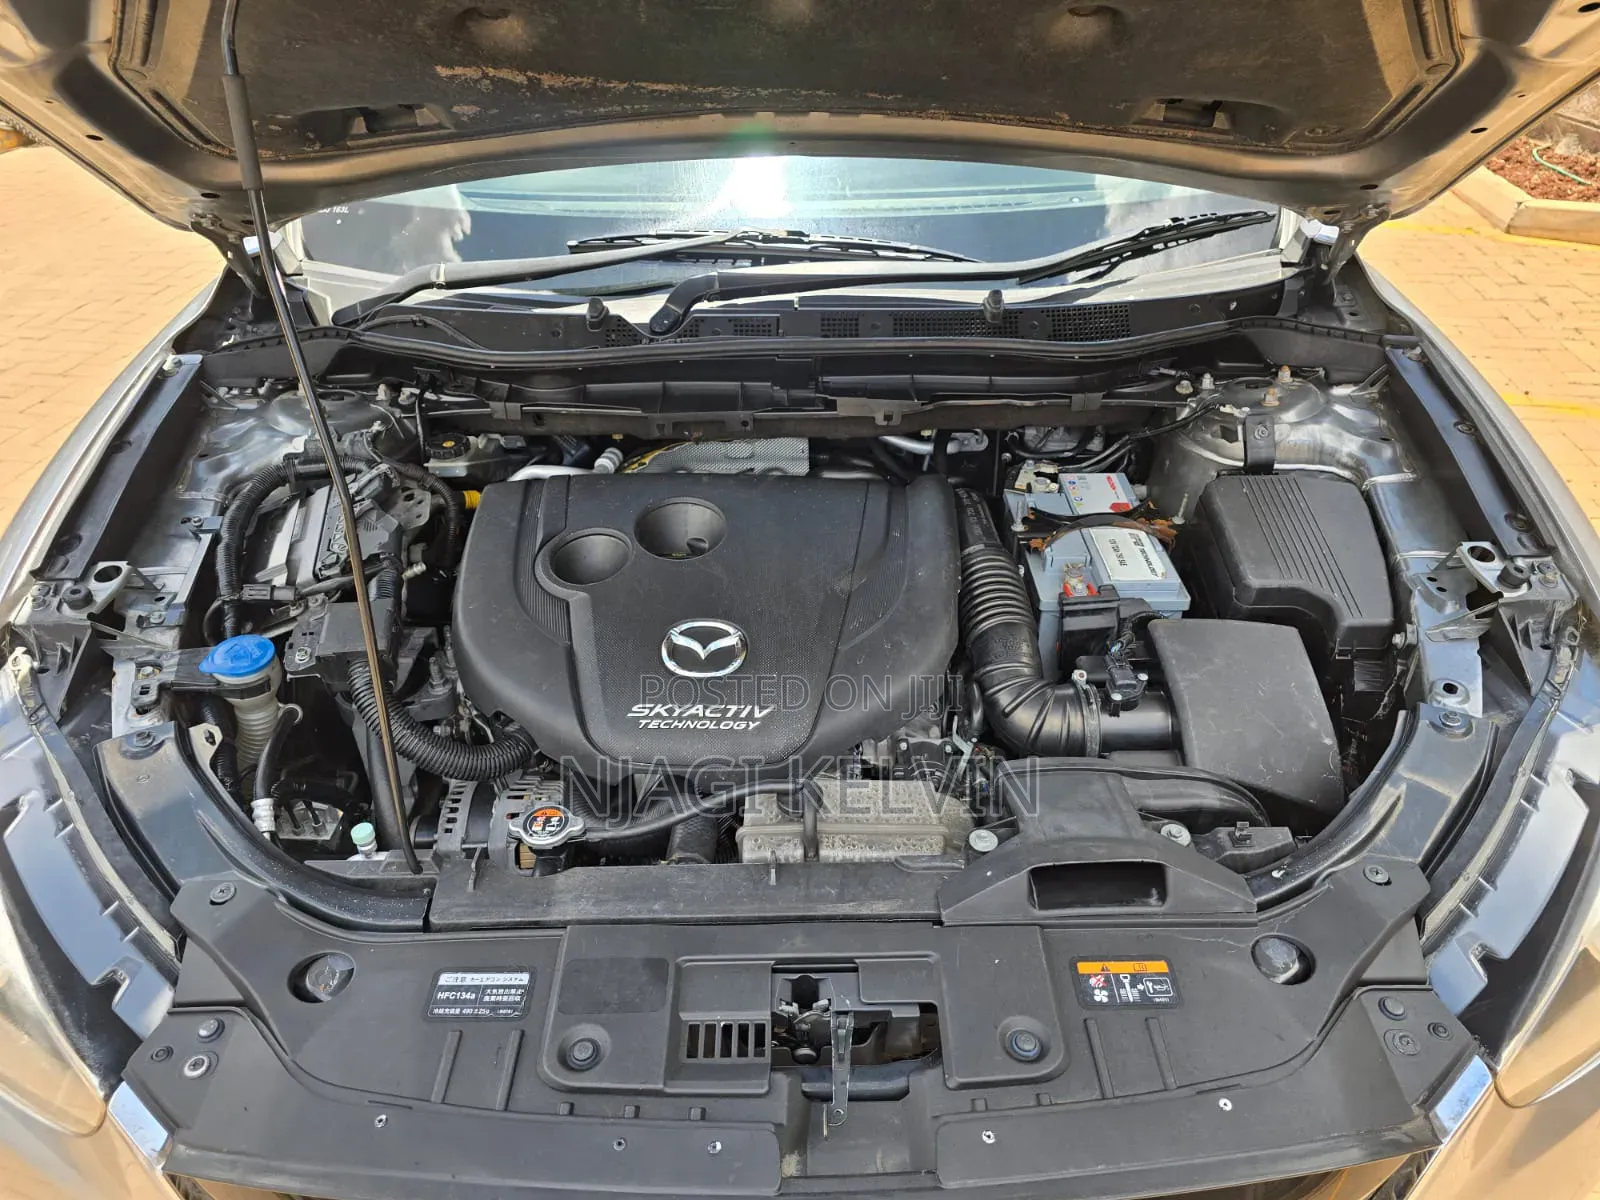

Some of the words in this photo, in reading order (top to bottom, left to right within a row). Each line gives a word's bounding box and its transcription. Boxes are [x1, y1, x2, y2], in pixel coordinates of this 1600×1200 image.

[626, 703, 775, 719] SKYACTIV
[638, 719, 761, 730] TECHNOLOGY
[437, 991, 476, 1000] HFC134a
